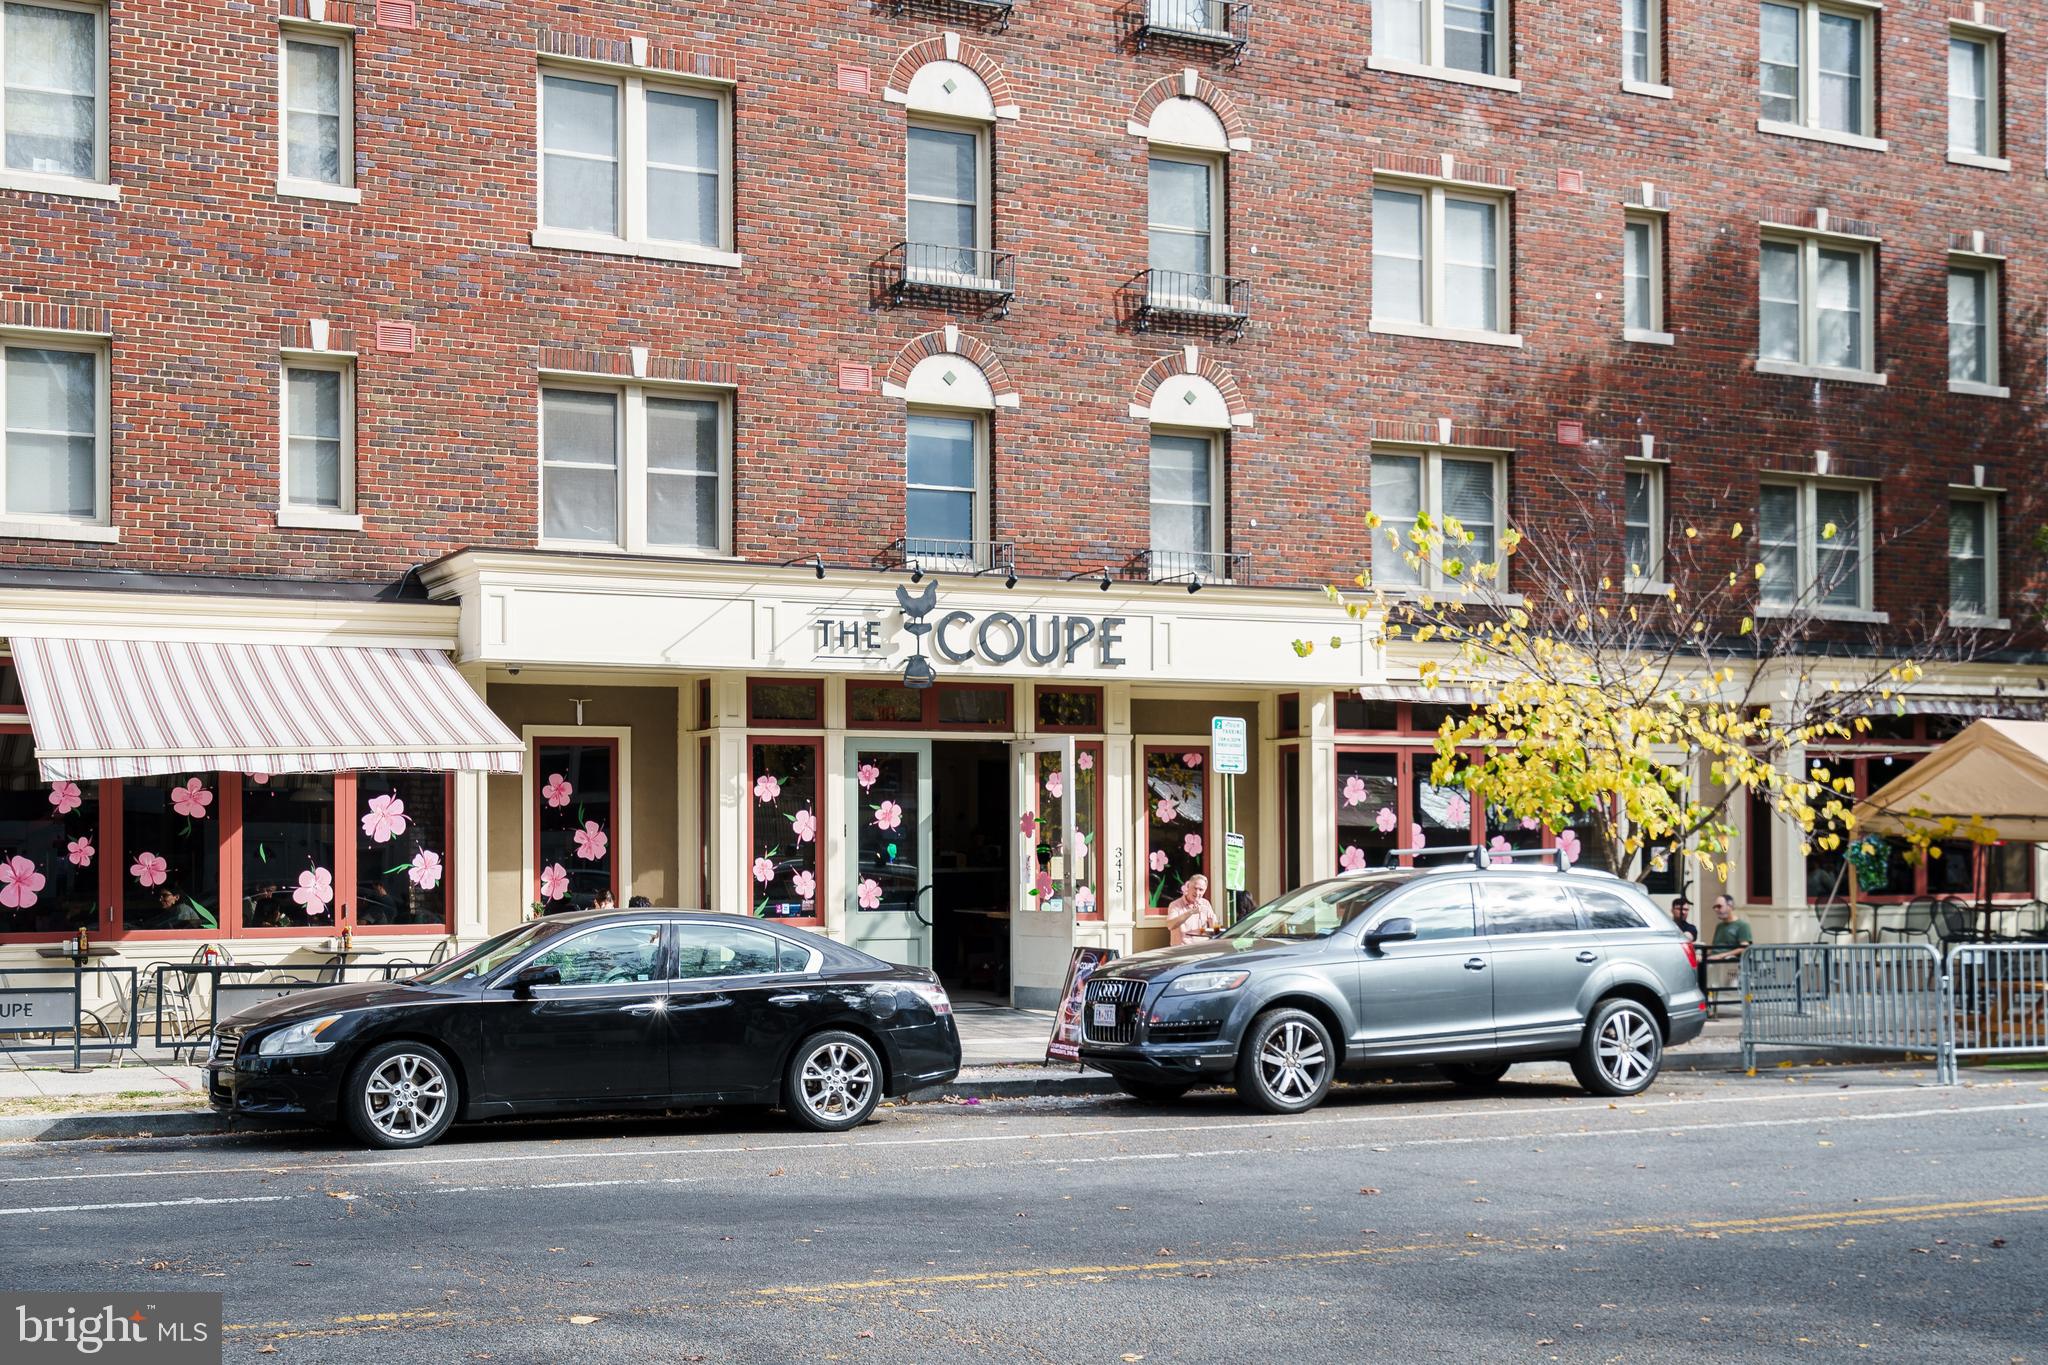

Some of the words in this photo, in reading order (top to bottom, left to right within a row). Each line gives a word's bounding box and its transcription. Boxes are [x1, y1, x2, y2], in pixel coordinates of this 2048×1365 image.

[816, 619, 881, 648] THE
[937, 610, 1126, 665] COUPE
[1215, 720, 1222, 729] 2
[1115, 847, 1123, 893] 3415
